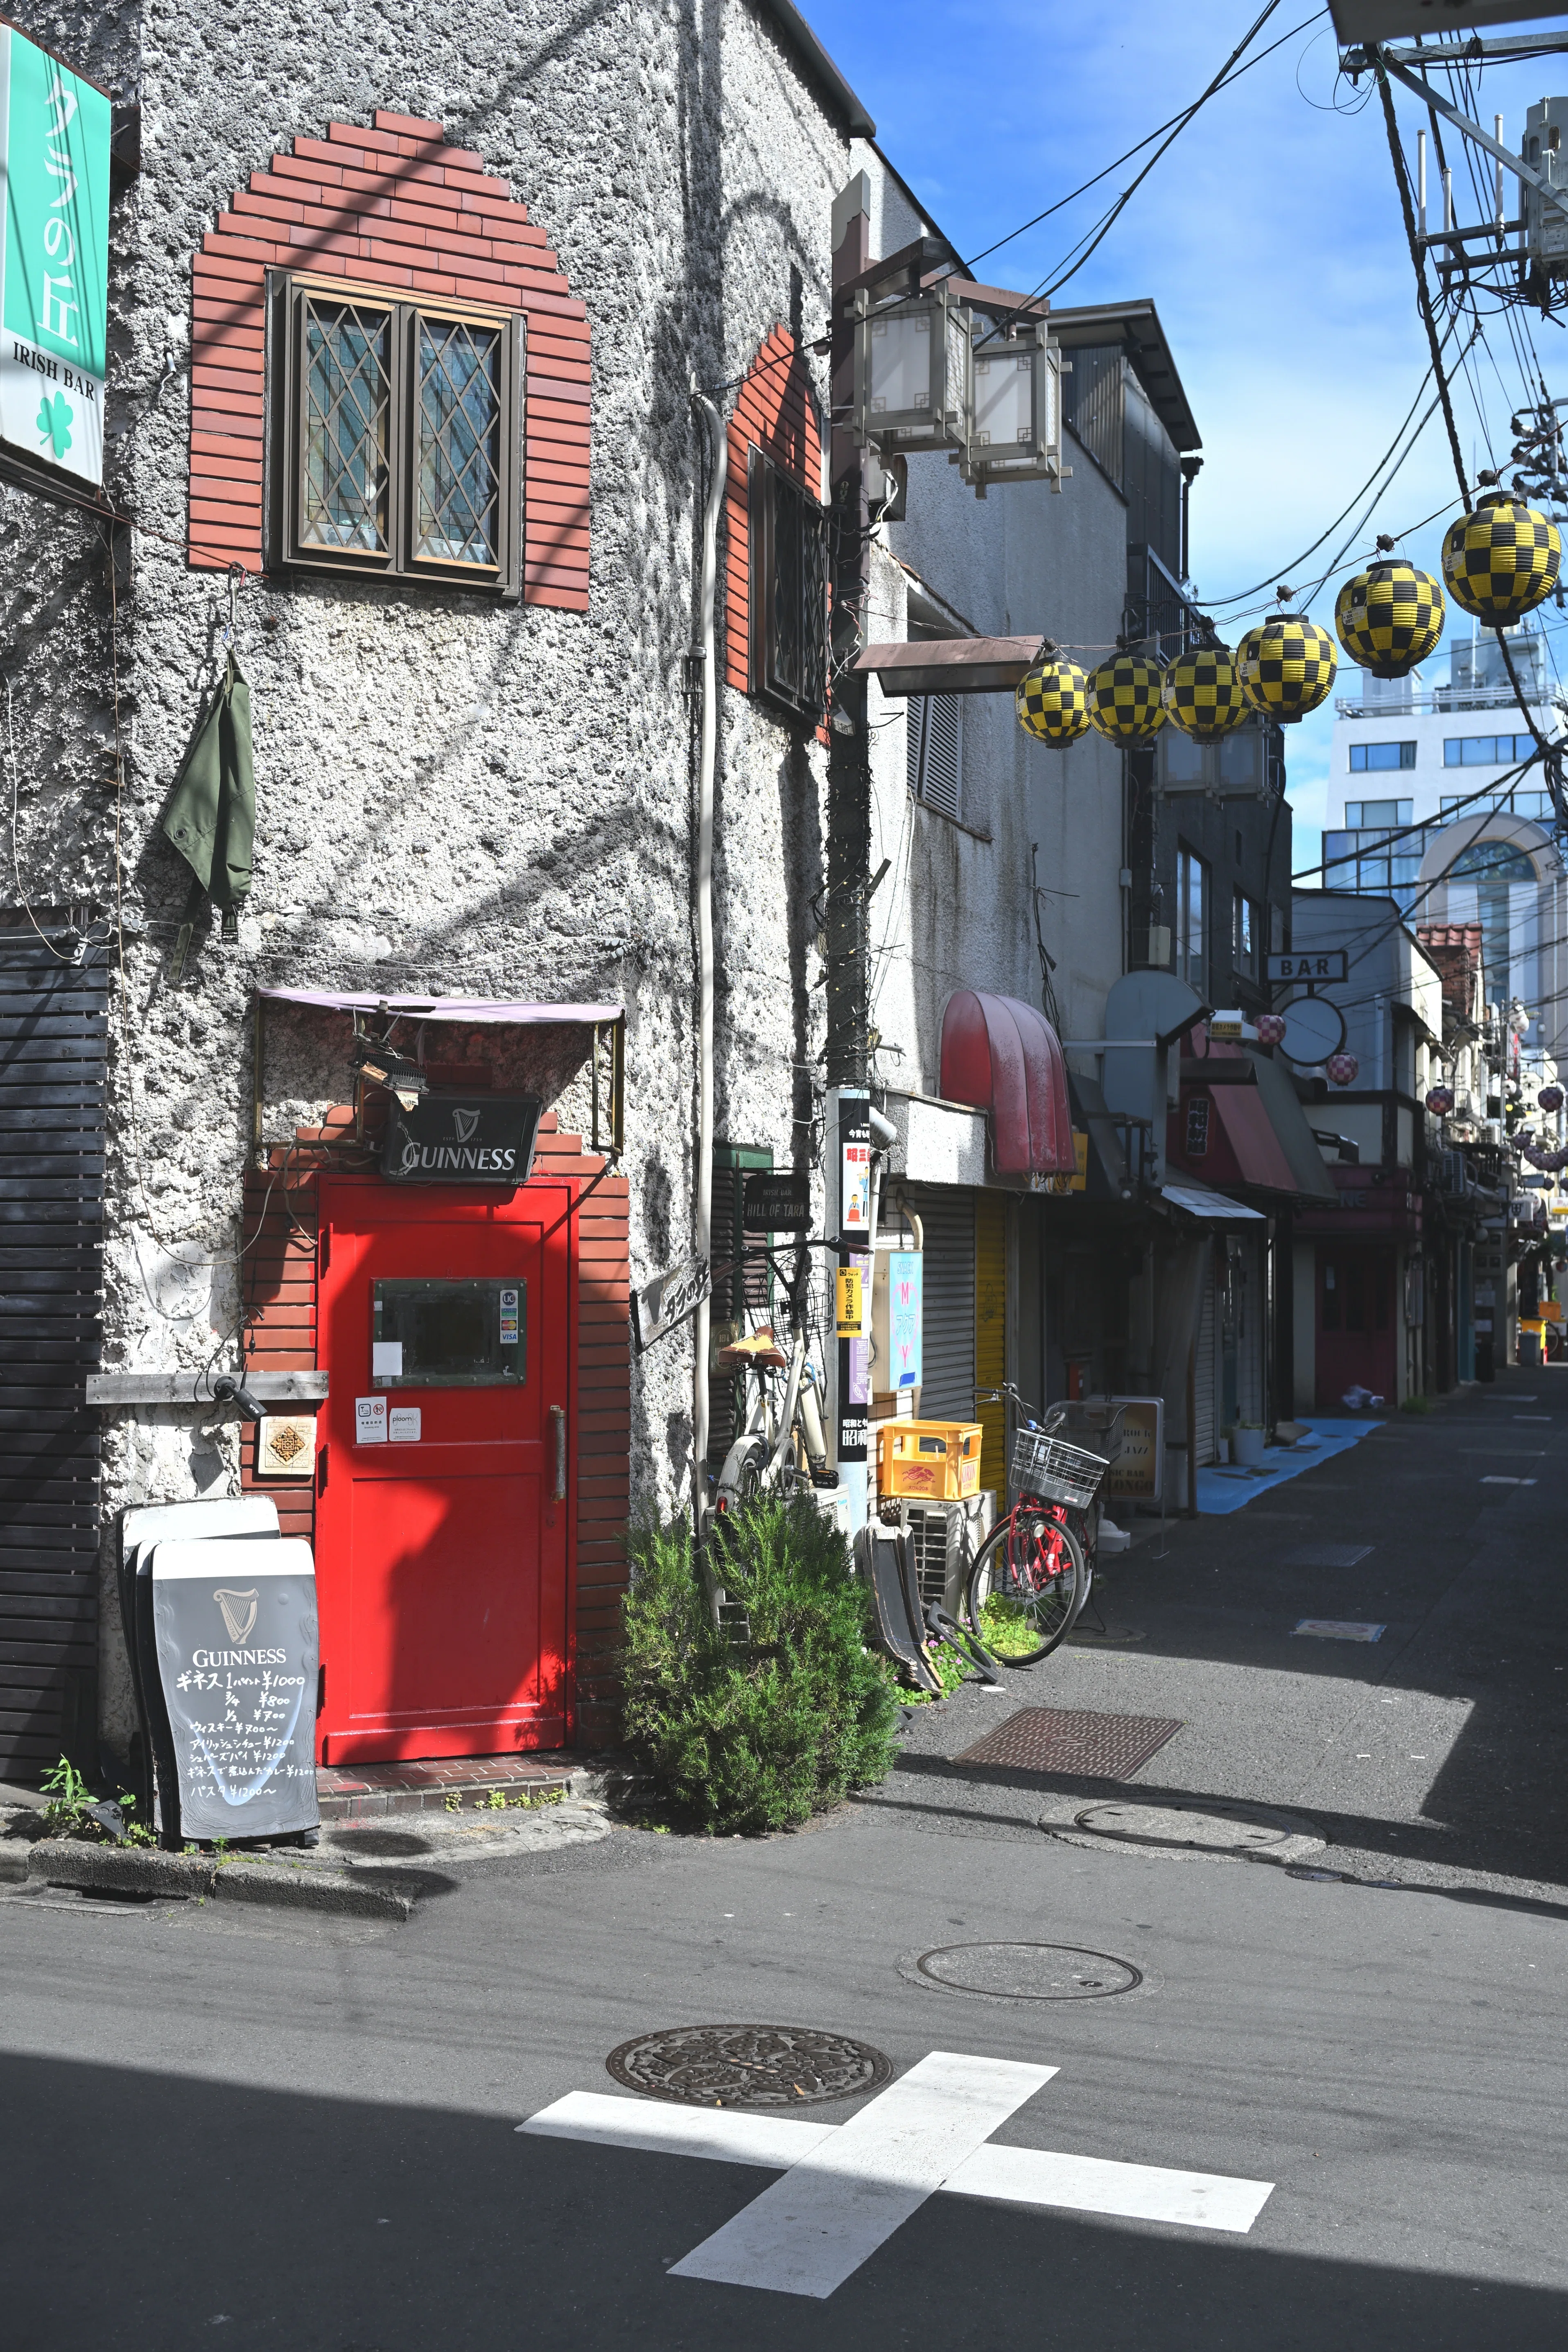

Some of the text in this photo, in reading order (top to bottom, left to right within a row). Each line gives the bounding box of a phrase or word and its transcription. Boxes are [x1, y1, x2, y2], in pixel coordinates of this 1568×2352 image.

[37, 72, 79, 347] タラの丘
[13, 341, 95, 402] IRISH BAR
[1281, 959, 1329, 976] BAR
[402, 1142, 515, 1170] GUINNESS
[747, 1204, 804, 1217] HILL OF TARA
[897, 1261, 913, 1274] SNACK
[845, 1278, 854, 1319] 防犯カメラ作動中
[896, 1314, 915, 1335] アクア
[393, 1415, 412, 1424] ploom
[1124, 1429, 1150, 1437] ROCK
[192, 1648, 287, 1667] GUINNESS
[176, 1670, 223, 1692] ギネス
[262, 1671, 305, 1690] ¥1000
[225, 1691, 290, 1708] 3/4 ¥800
[225, 1709, 285, 1722] 1/2 ¥700
[190, 1721, 233, 1733] ウィスキー
[190, 1736, 294, 1750] アイリッシュシチュー ¥1200
[253, 1750, 285, 1762] ¥1200
[286, 1765, 314, 1778] ¥1200
[191, 1785, 225, 1798] パスタ
